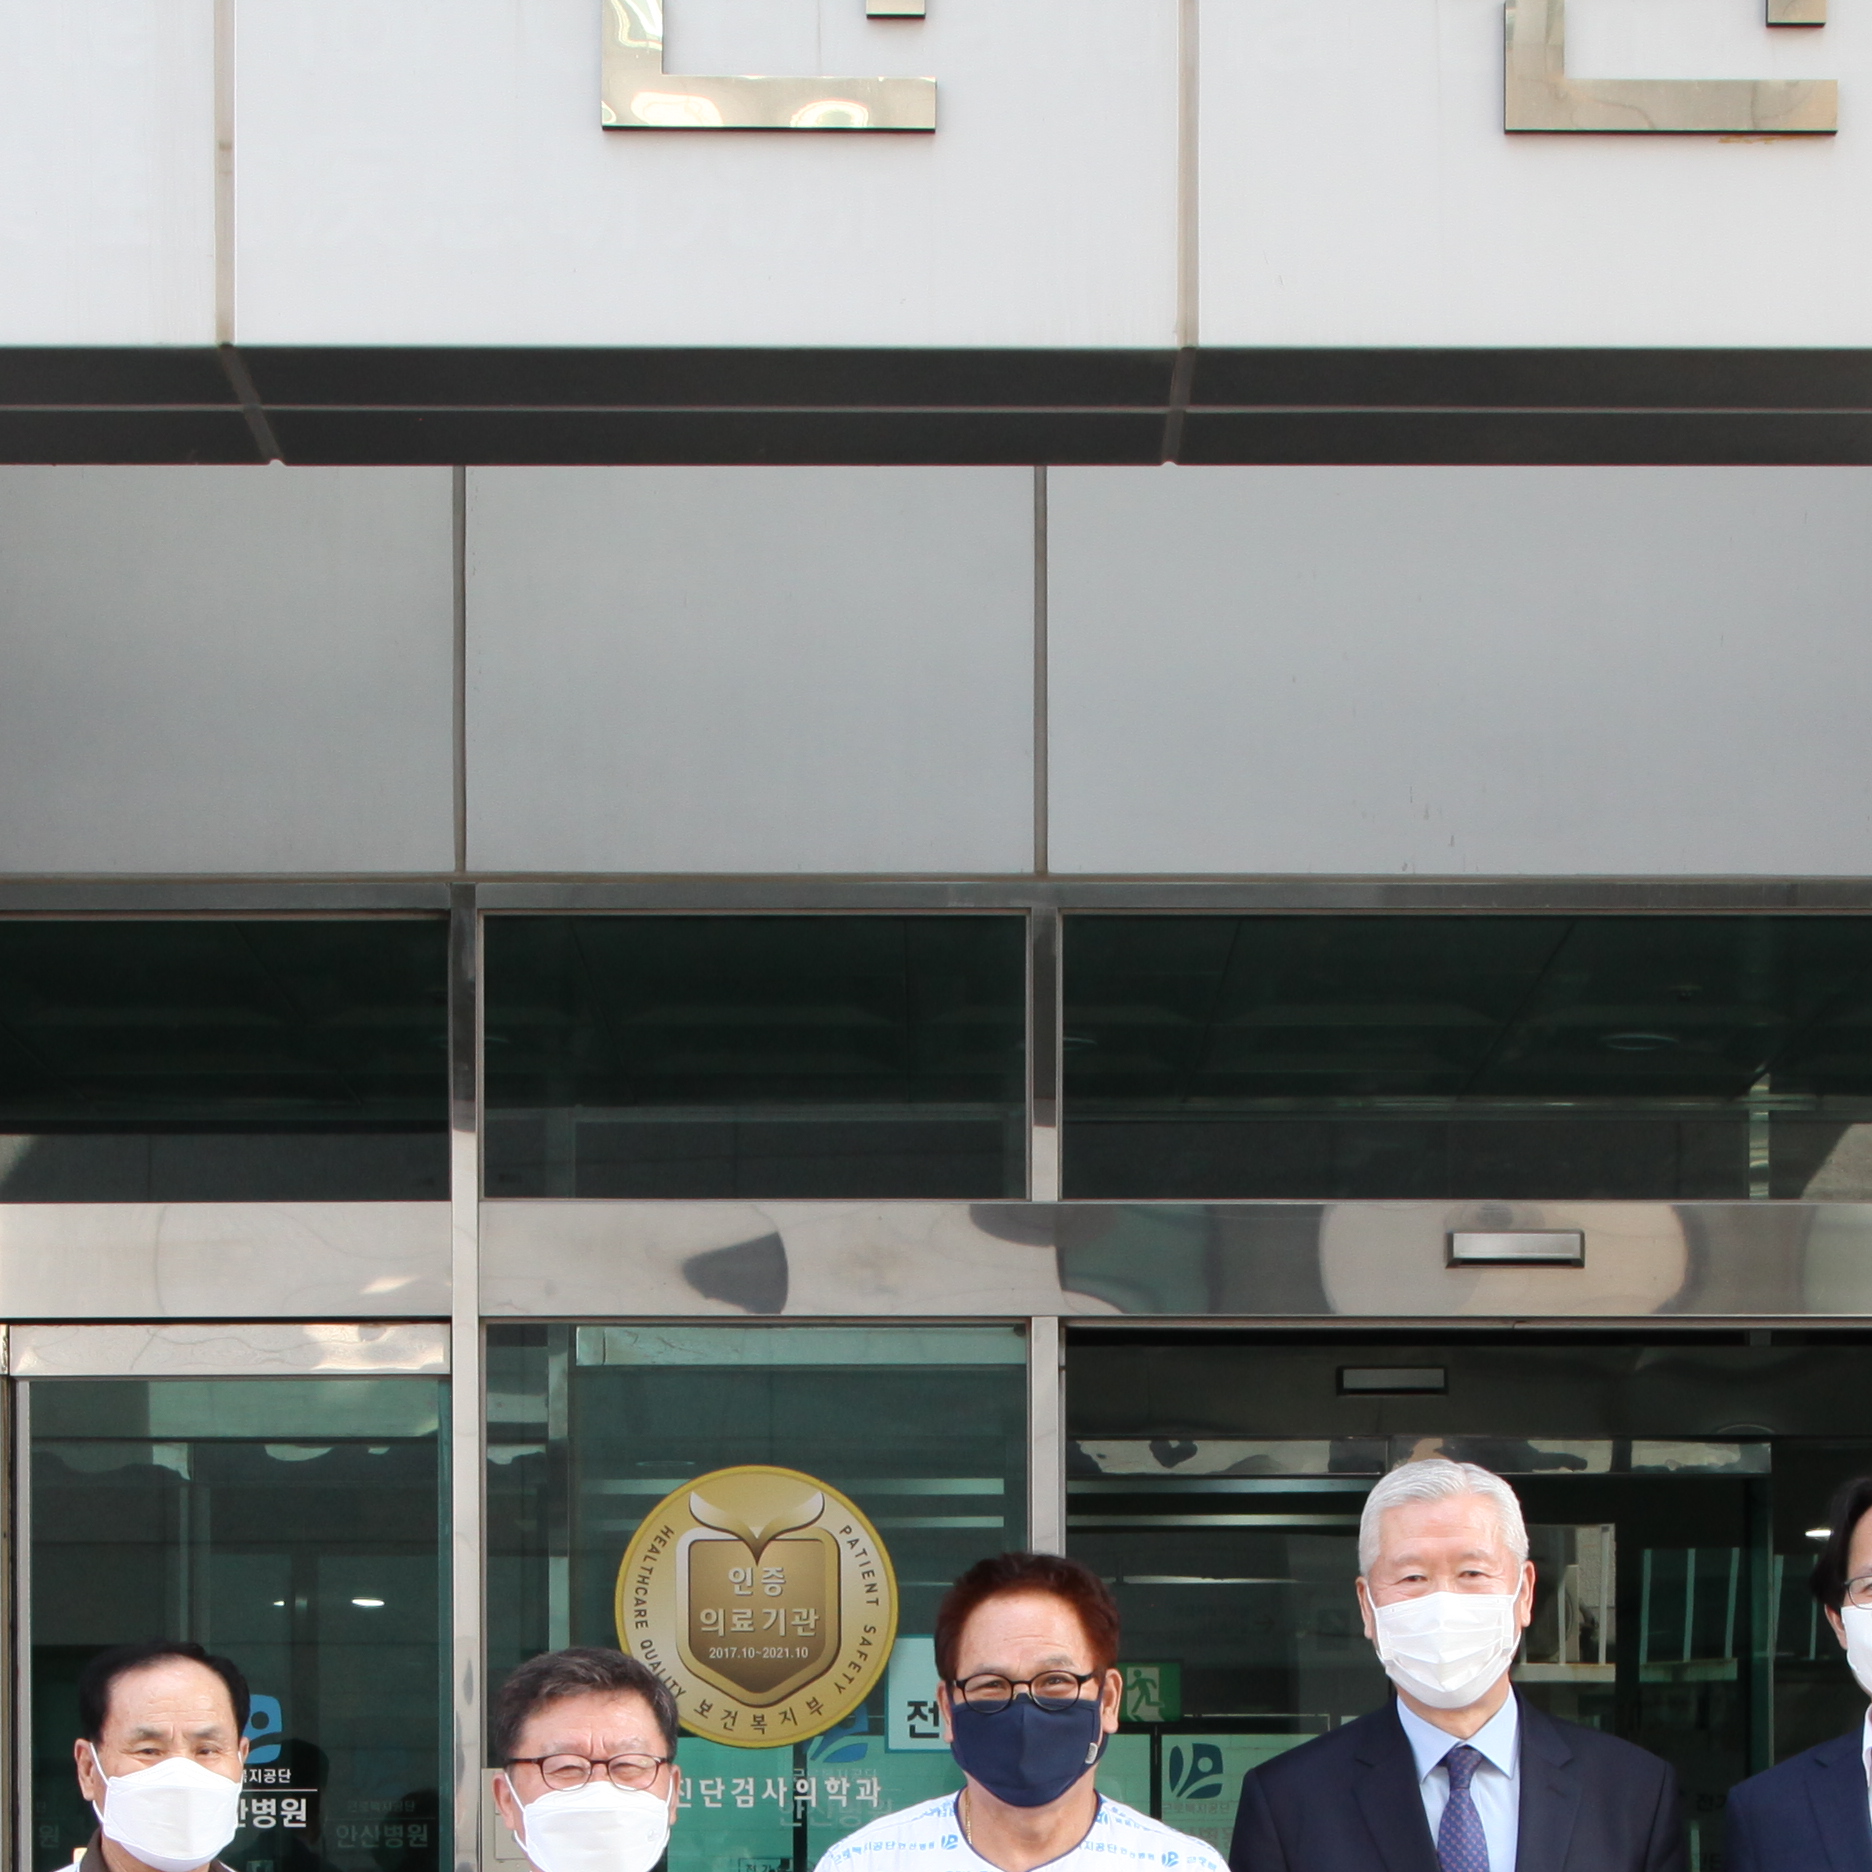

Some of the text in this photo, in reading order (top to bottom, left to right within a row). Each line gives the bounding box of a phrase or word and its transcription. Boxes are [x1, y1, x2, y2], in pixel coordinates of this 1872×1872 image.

[634, 1525, 674, 1630] HEALTHCARE
[699, 1607, 820, 1638] 의료기관
[834, 1525, 880, 1695] PATIENT SAFETY
[708, 1647, 809, 1660] 2017.10~2021.10
[694, 1696, 825, 1735] 보건복지부
